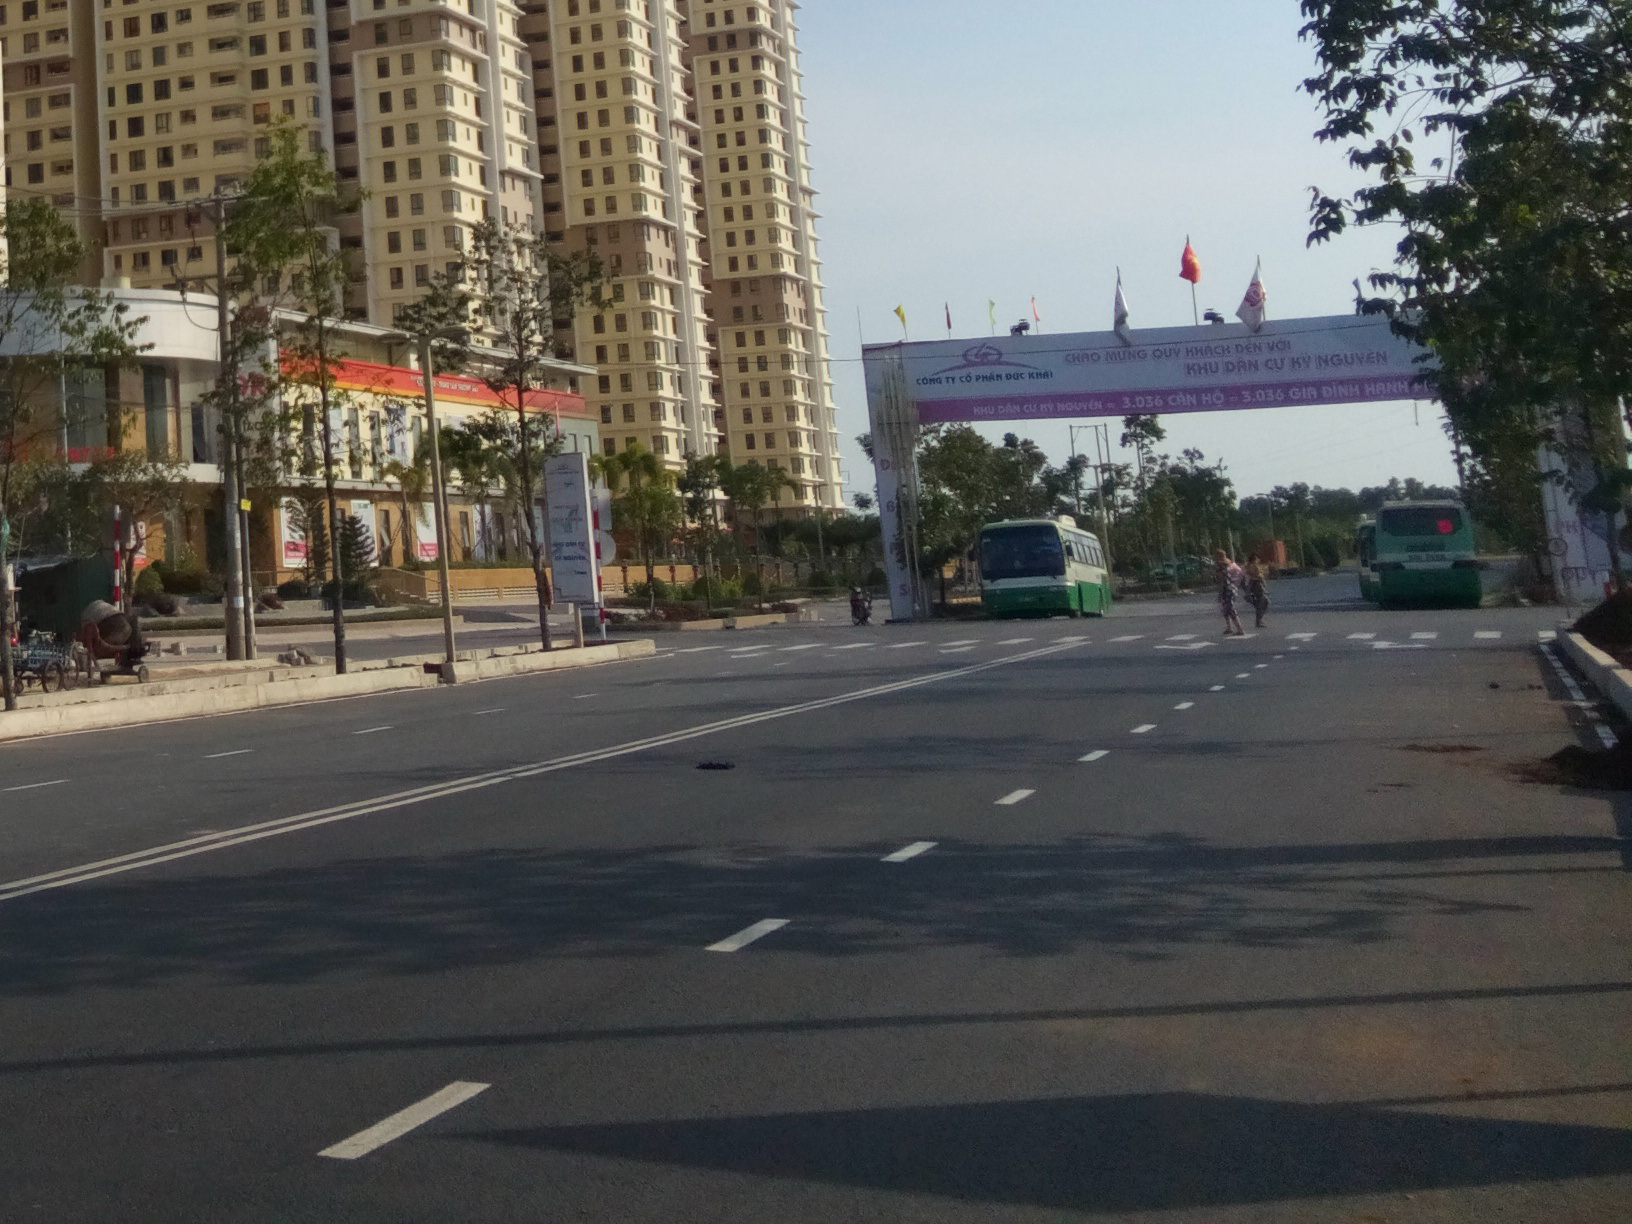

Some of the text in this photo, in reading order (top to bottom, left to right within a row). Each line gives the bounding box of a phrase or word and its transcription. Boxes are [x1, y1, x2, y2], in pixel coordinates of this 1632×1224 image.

[1185, 361, 1220, 376] KHU
[1121, 395, 1164, 409] 3.036
[1241, 389, 1285, 403] 3.036
